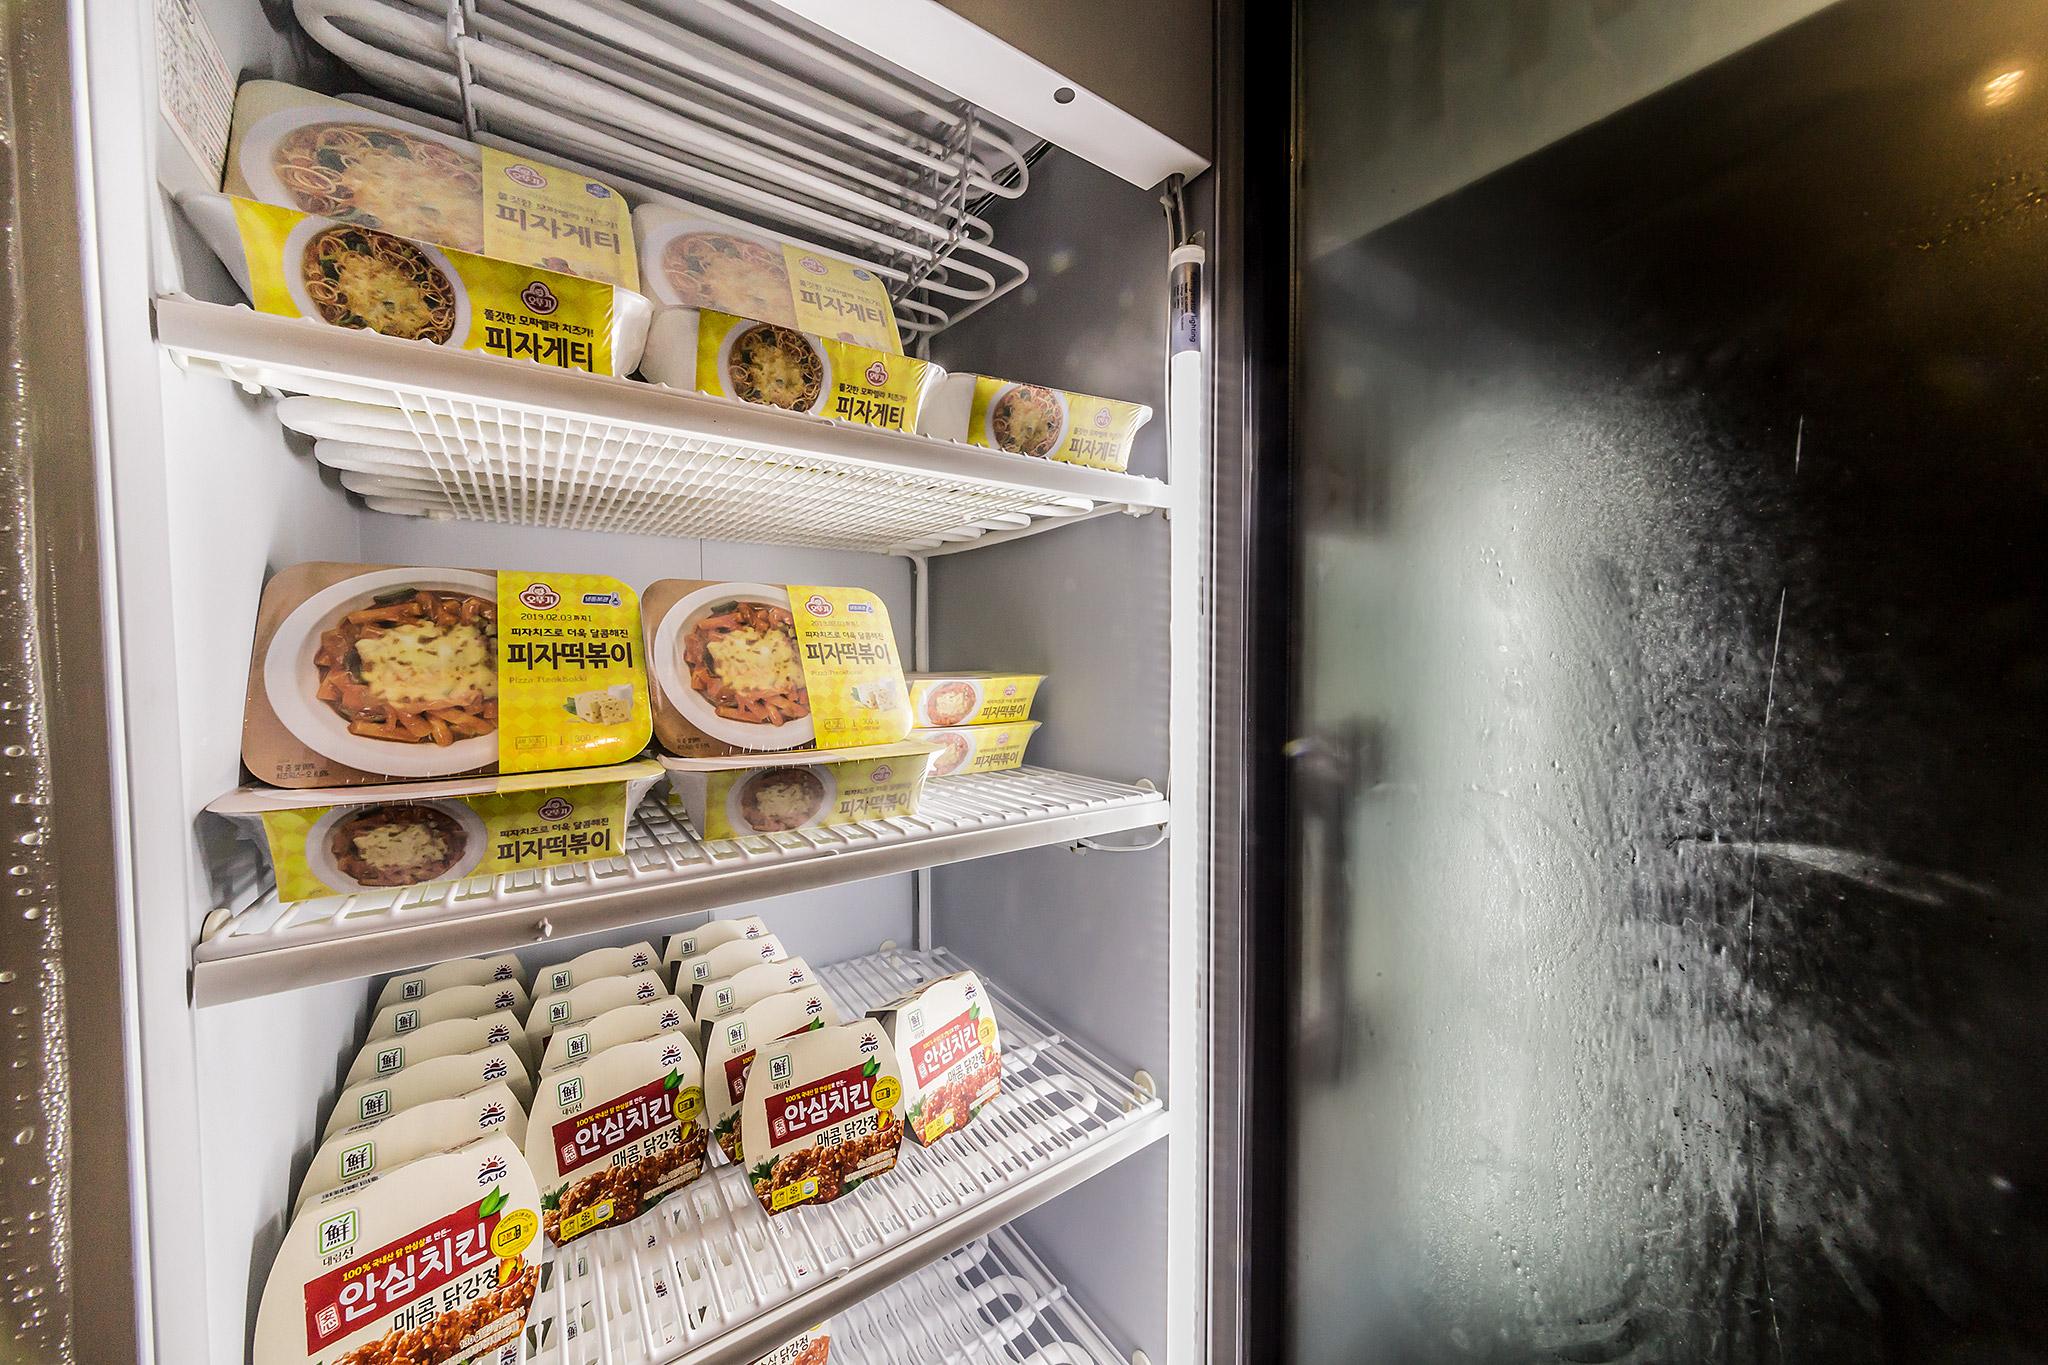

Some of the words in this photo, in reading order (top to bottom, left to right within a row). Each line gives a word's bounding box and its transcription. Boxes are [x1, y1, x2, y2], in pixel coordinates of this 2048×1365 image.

[496, 203, 621, 254] 피자게티
[484, 308, 516, 325] 쫄깃한
[800, 289, 887, 328] 피자게티
[485, 326, 593, 373] 피자게티
[835, 396, 905, 429] 피자게티
[1069, 438, 1121, 462] 피자게티
[526, 594, 555, 605] 오뚜기
[511, 628, 564, 638] 피자치즈로
[567, 628, 587, 639] 더욱
[590, 628, 629, 639] 달콤해진
[507, 642, 633, 671] 피자떡볶이
[805, 642, 892, 665] 피자떡볶이
[981, 703, 1026, 719] 피자떡볶이
[839, 790, 912, 817] 피자떡볶이
[500, 825, 549, 838] 피자치즈로
[497, 828, 610, 863] 피자떡볶이
[495, 1000, 515, 1010] SAJO
[638, 991, 655, 1000] SAJO
[806, 1006, 823, 1016] SAJO
[660, 1019, 680, 1030] SAJO
[488, 1035, 510, 1044] SAJO
[861, 1044, 879, 1054] SAJO
[924, 1023, 979, 1074] 안심치킨
[661, 1055, 682, 1068] SAJO
[483, 1070, 507, 1081] SAJO
[784, 1080, 870, 1131] 안심치킨
[479, 1115, 506, 1129] SAJO
[575, 1094, 673, 1157] 안심치킨
[576, 1114, 595, 1128] 100%
[817, 1126, 842, 1148] 매콤
[844, 1113, 879, 1139] 닭강정
[612, 1144, 641, 1168] 매콤
[643, 1125, 682, 1157] 닭강정
[478, 1170, 507, 1187] SAJO
[338, 1221, 488, 1323] 안심치킨
[342, 1261, 372, 1282] 100%
[371, 1251, 395, 1268] 국내산
[393, 1296, 438, 1332] 매콤
[442, 1264, 500, 1311] 닭강정
[780, 1334, 809, 1364] 닭강정
